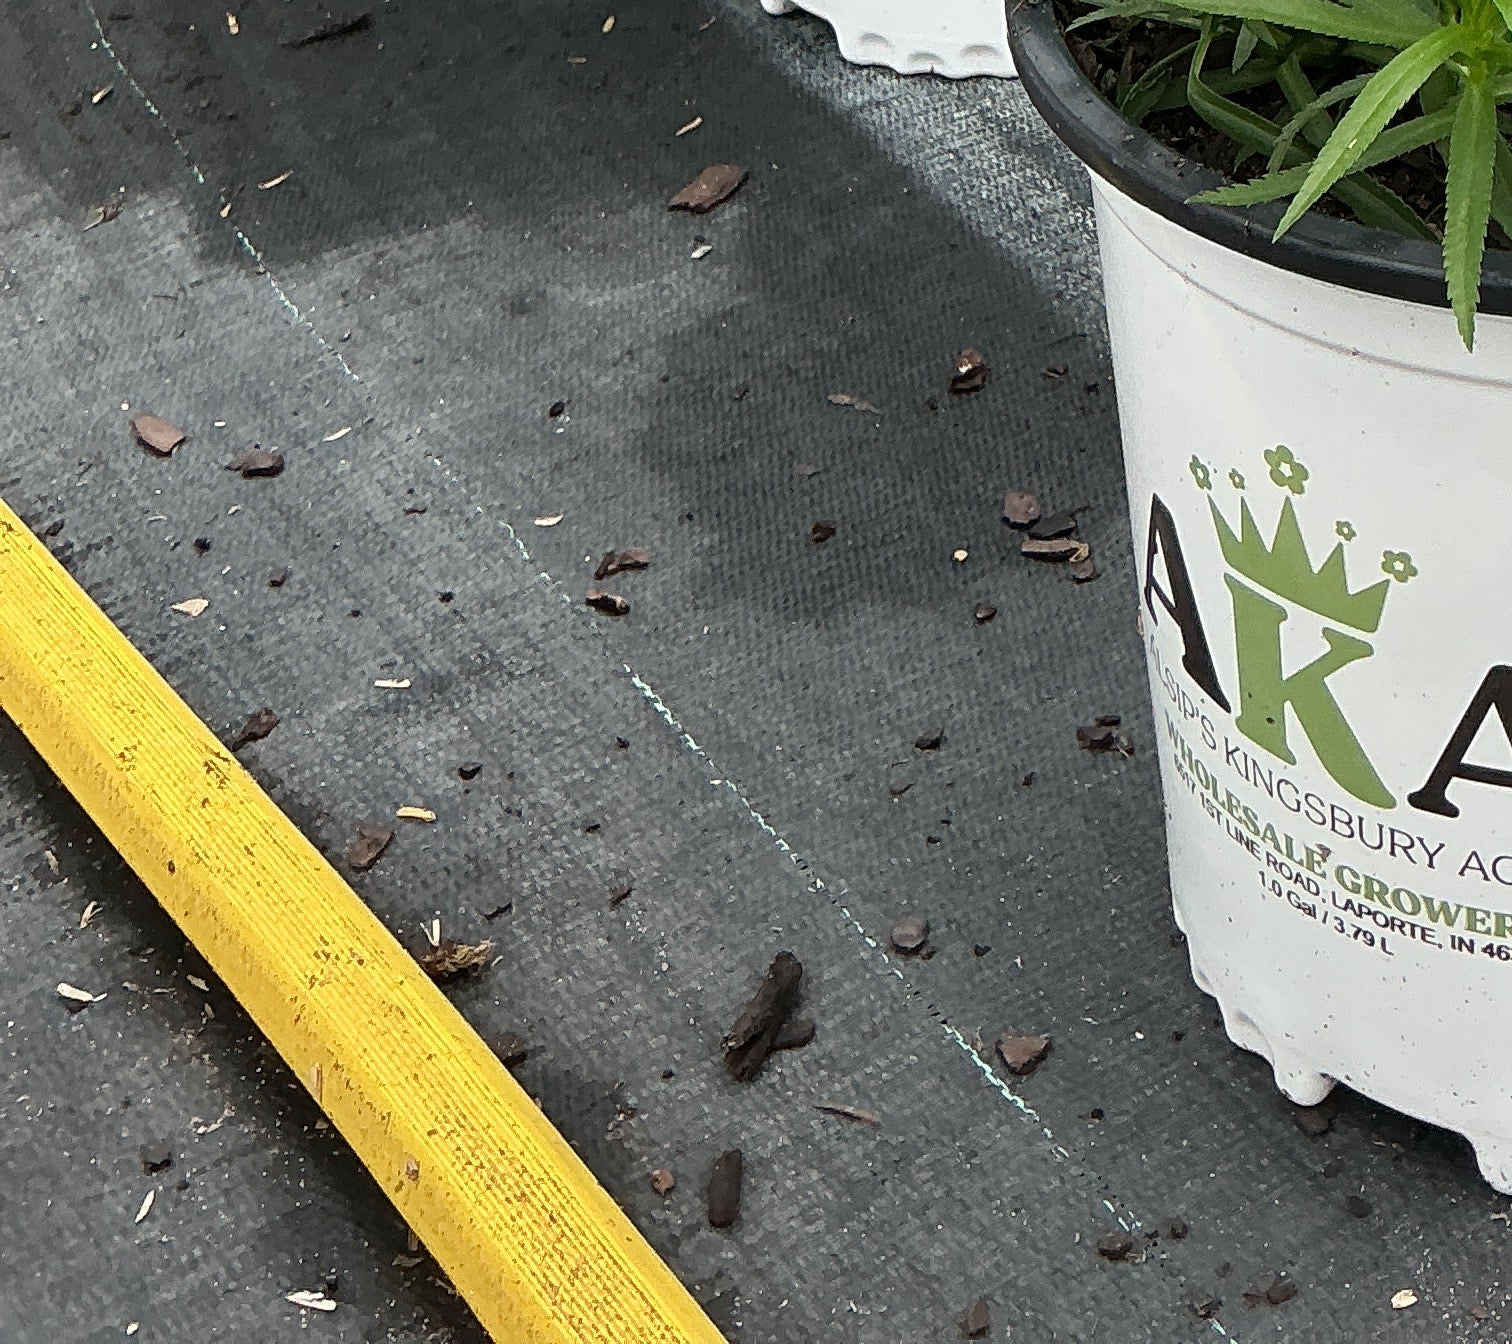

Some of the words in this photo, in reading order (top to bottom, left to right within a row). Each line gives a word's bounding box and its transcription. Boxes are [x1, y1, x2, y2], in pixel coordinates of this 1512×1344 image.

[1150, 632, 1218, 752] ALSIP'S
[1223, 734, 1446, 870] KINGSBURY
[1164, 708, 1328, 881] WHOLESALE
[1199, 791, 1223, 827] 1ST
[1225, 817, 1263, 862] LINE
[1449, 933, 1476, 955] IN
[1257, 869, 1283, 899] 1.0
[1286, 888, 1317, 921] Gal
[1332, 914, 1377, 949] 3.79
[1379, 935, 1396, 957] L
